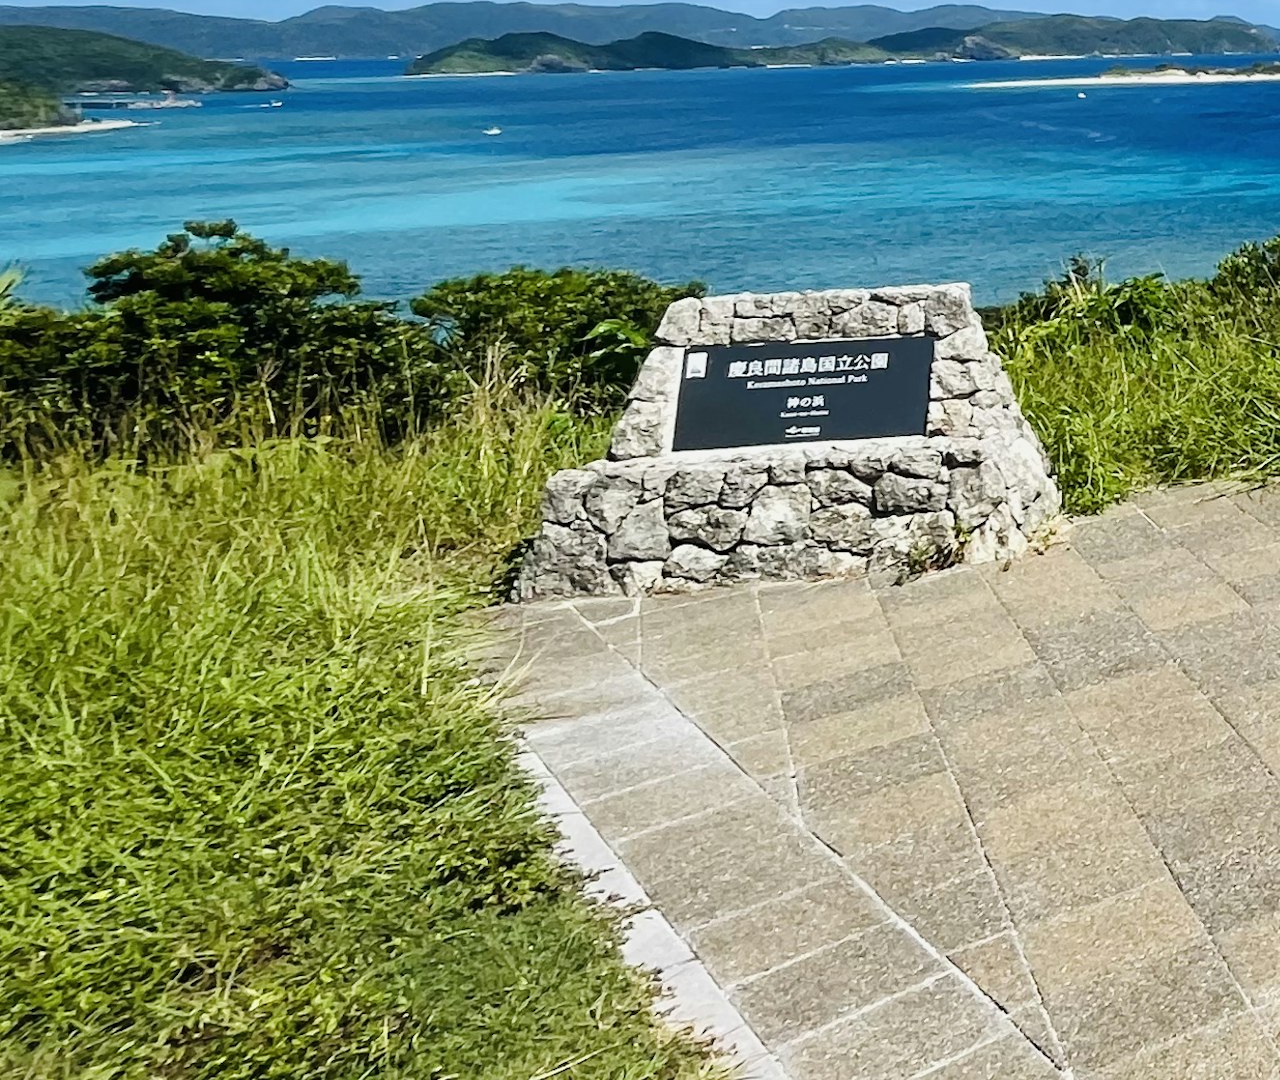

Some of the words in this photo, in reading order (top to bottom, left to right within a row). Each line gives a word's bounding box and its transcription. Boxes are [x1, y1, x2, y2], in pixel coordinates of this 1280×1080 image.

[727, 352, 889, 378] 慶良間諸島国立公園
[807, 375, 846, 386] National
[847, 374, 868, 384] Park
